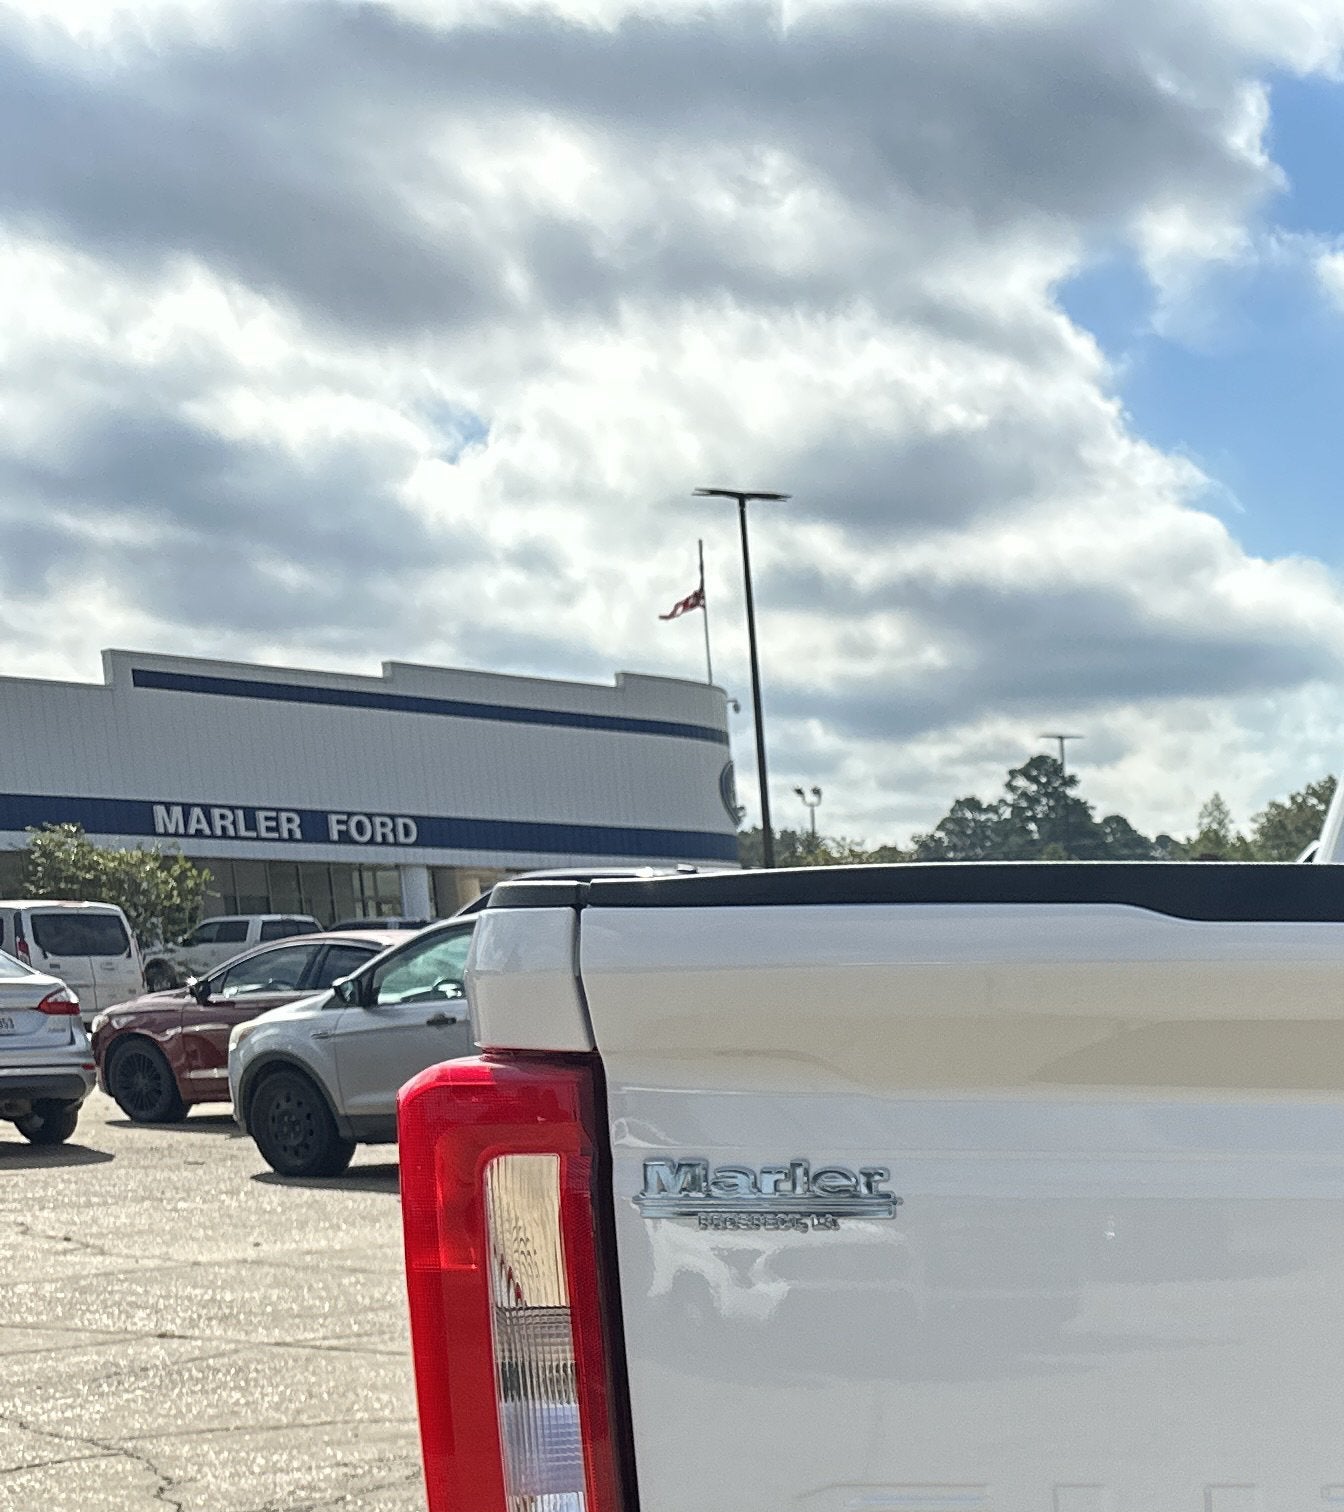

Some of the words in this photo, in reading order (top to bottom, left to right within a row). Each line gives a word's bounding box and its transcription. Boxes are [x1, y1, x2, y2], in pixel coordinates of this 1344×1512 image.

[153, 804, 303, 840] MARLER
[327, 813, 419, 845] FORD
[642, 1158, 895, 1198] Marler
